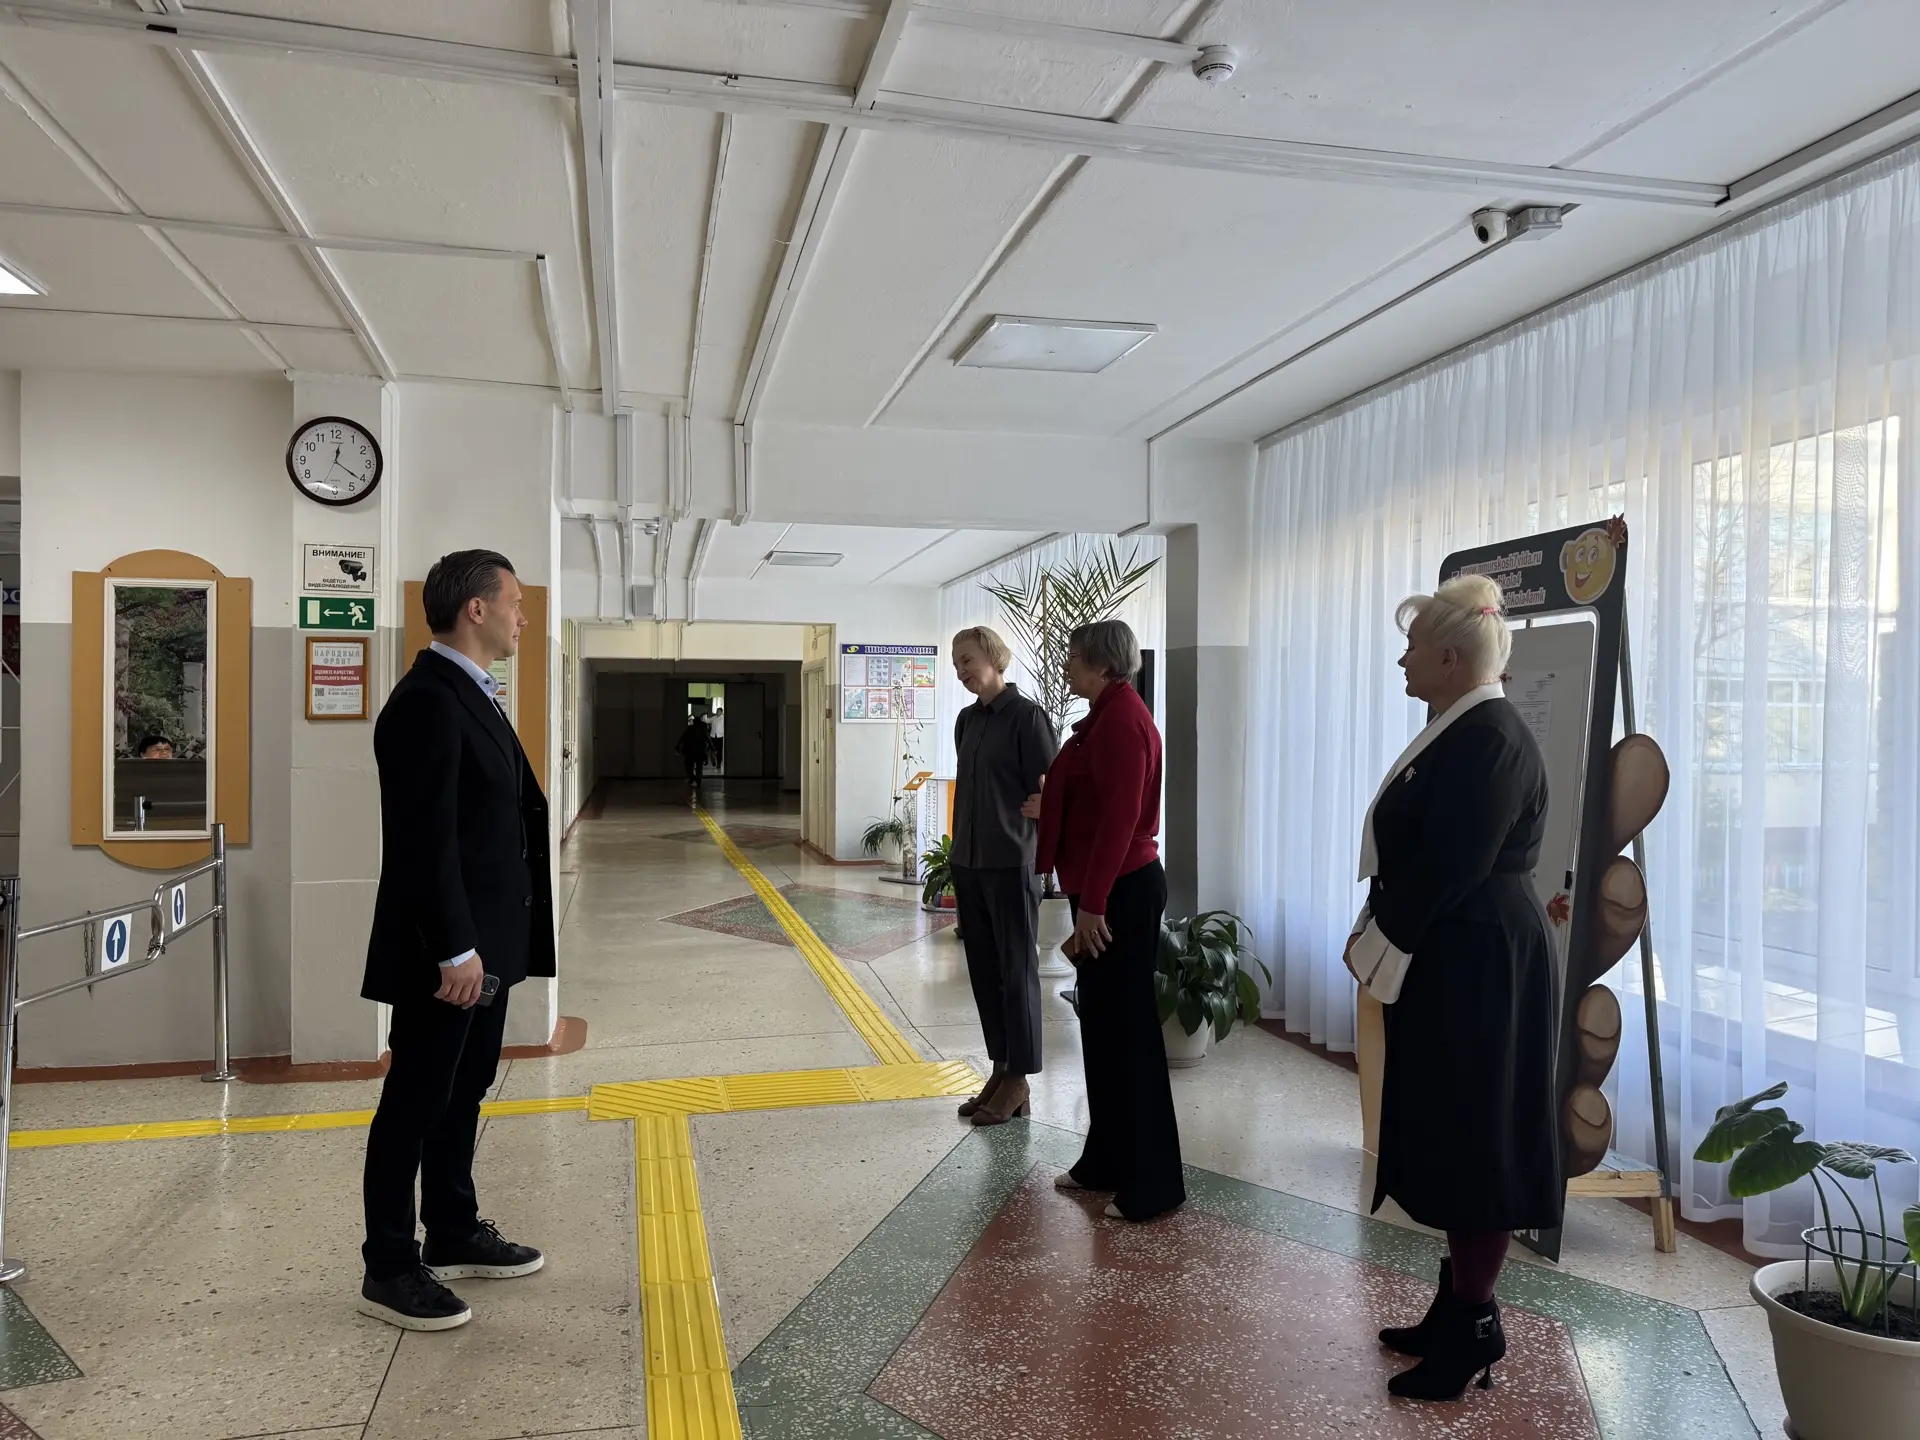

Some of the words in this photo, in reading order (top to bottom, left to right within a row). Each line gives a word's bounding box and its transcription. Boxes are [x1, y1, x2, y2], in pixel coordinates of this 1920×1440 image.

[316, 433, 325, 442] 11
[330, 429, 342, 439] 12
[350, 435, 355, 444] 1
[305, 442, 316, 452] 10
[360, 445, 367, 455] 2
[299, 455, 306, 465] 9
[365, 460, 372, 469] 3
[304, 469, 311, 479] 8
[360, 474, 367, 483] 4
[348, 482, 355, 492] 5
[312, 549, 366, 559] ВНИМАНИЕ!
[308, 582, 361, 590] ВИДЕОНАБЛЮДЕНИЕ
[314, 649, 360, 657] НАРОДНЫЙ
[864, 645, 934, 655] ИНФОРМАЦИЯ
[323, 657, 351, 665] ФРОНТ
